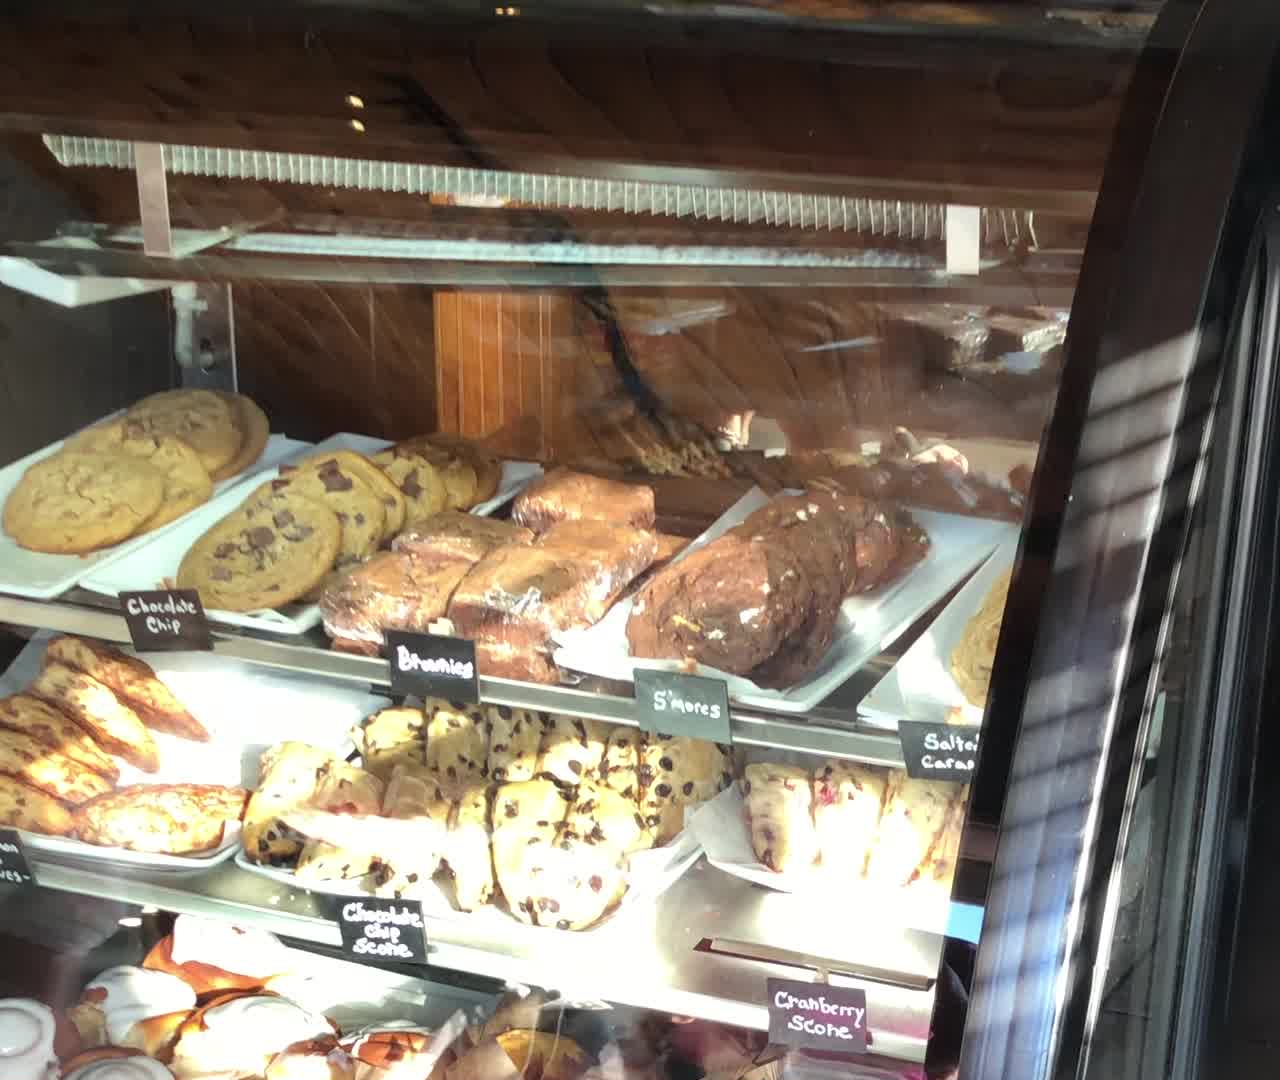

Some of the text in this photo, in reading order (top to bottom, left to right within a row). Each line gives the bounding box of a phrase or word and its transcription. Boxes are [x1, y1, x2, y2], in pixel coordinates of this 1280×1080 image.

[127, 594, 198, 616] Chocolate
[145, 615, 181, 635] Chip
[396, 644, 474, 680] Brownies
[342, 901, 424, 928] Chocolate
[774, 990, 865, 1029] Cranberry
[787, 1014, 853, 1040] Scone
